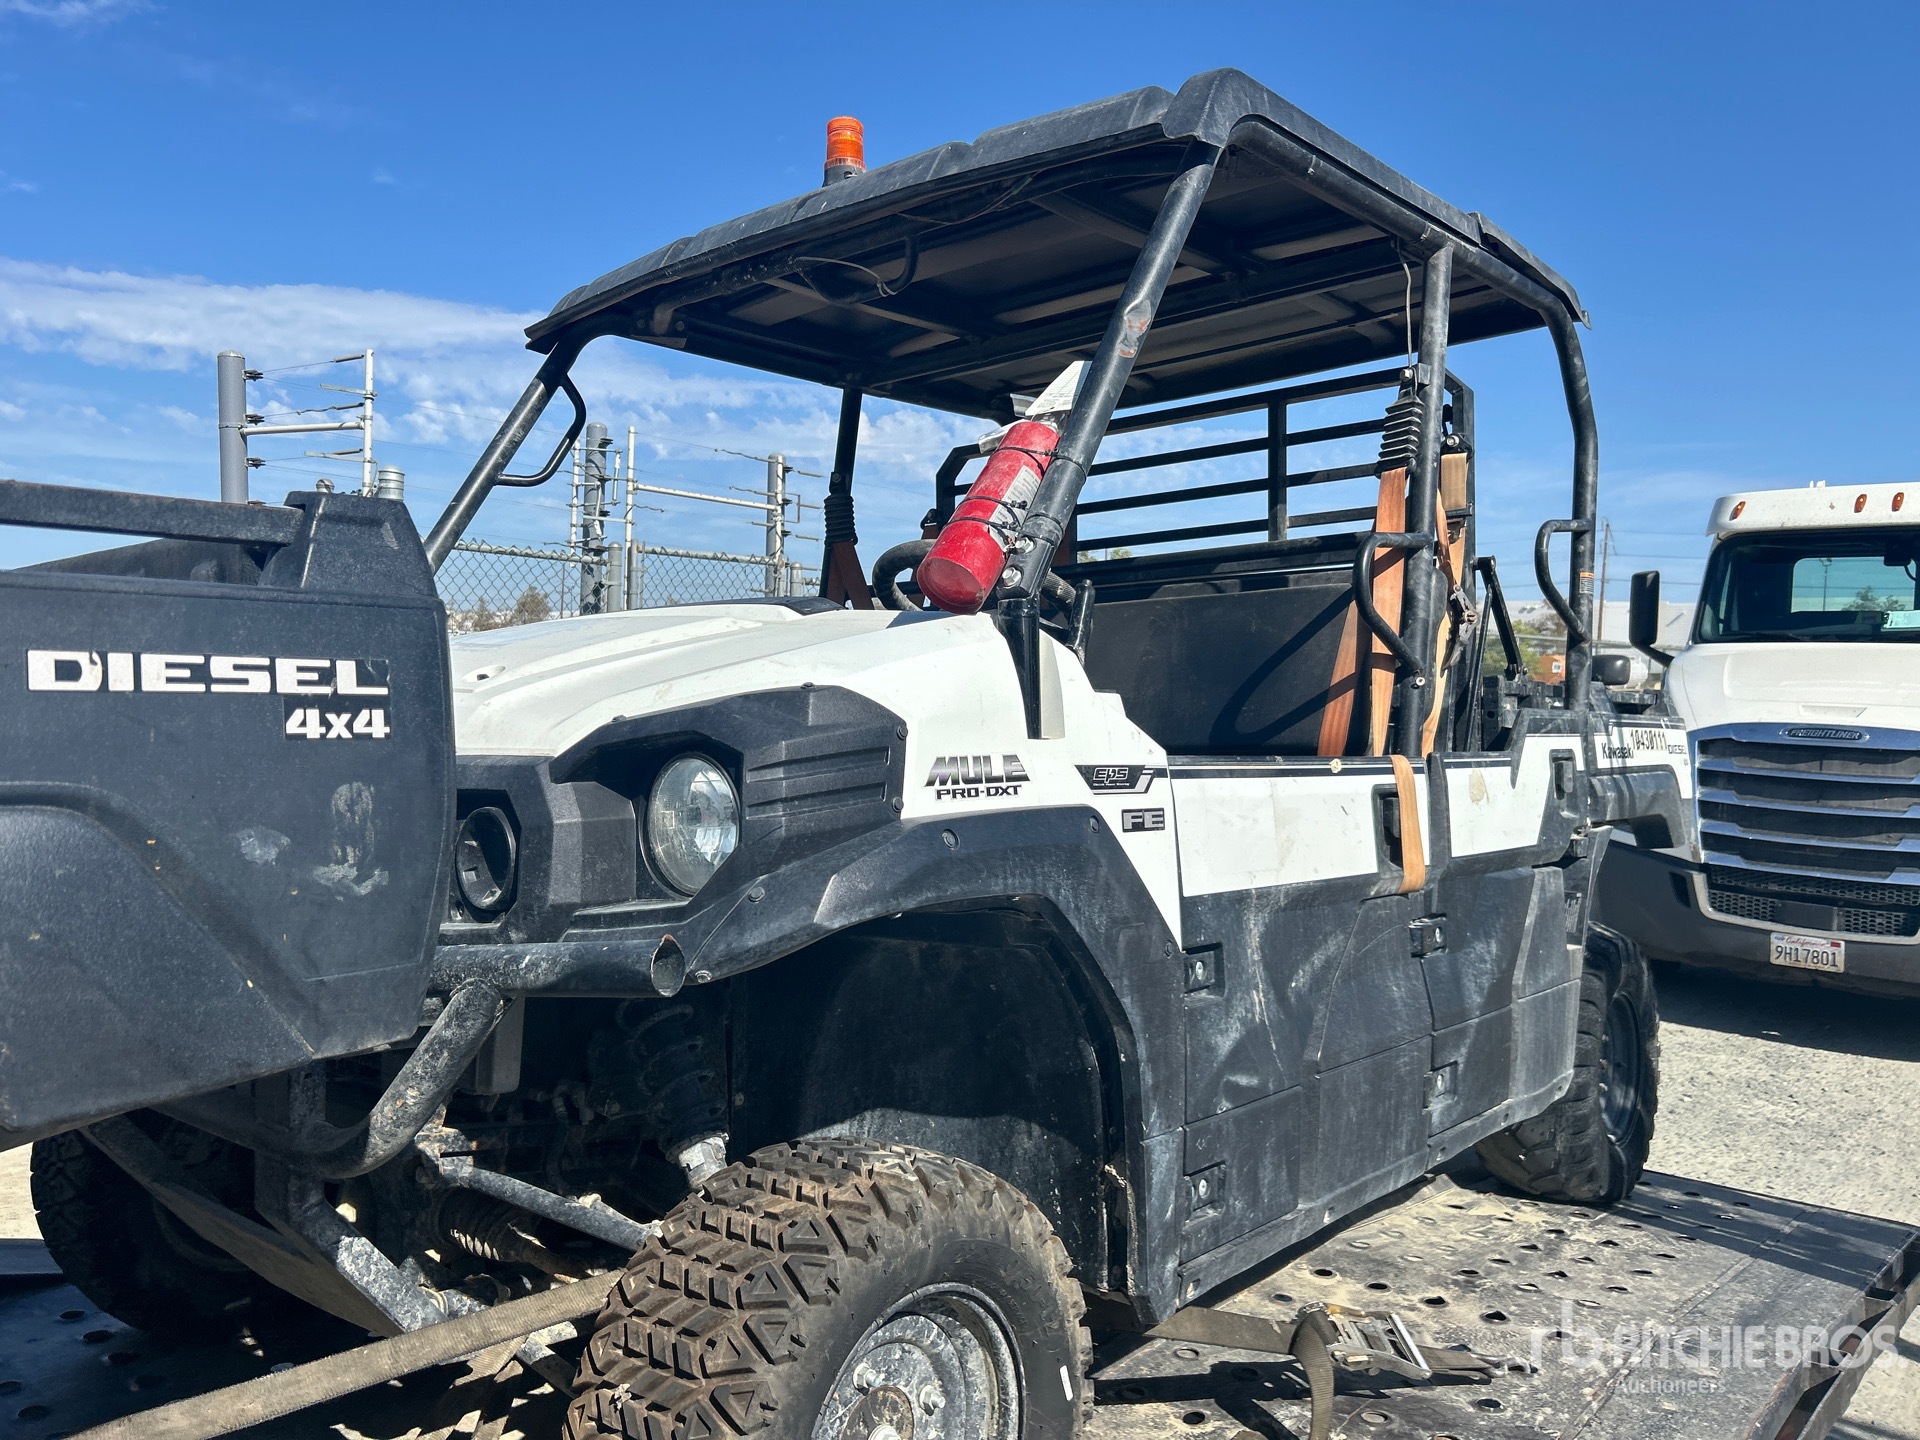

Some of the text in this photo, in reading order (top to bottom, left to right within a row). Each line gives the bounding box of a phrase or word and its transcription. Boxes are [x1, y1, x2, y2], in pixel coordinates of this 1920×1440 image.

[27, 650, 389, 694] DIESEL
[285, 708, 390, 738] 4x4
[1790, 729, 1859, 739] FREIGHTLINER
[1601, 743, 1634, 759] Kawasaki
[925, 754, 1031, 787] MULE
[935, 784, 1022, 800] PRO-DXT
[1122, 810, 1164, 830] FE
[1786, 935, 1826, 947] California
[1775, 945, 1838, 967] 9H17801
